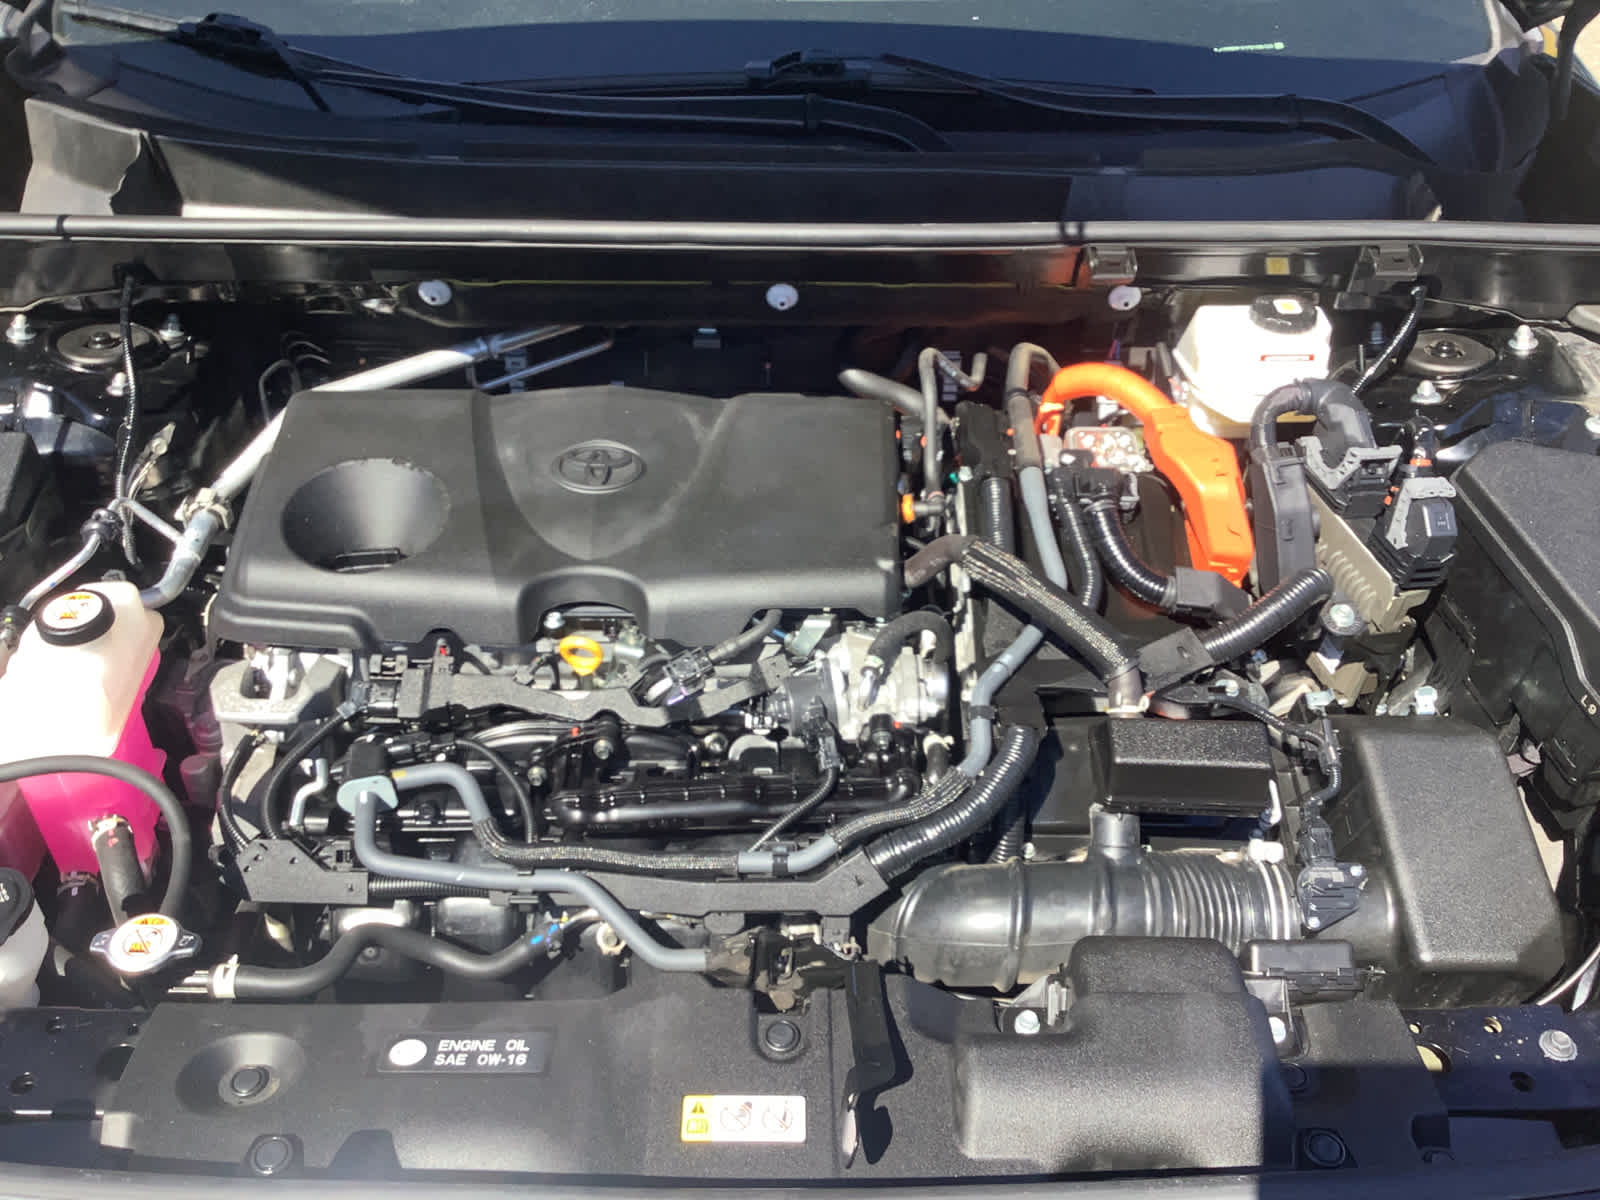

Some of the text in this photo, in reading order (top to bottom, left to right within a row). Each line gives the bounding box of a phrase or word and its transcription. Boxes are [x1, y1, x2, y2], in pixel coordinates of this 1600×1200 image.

[438, 1039, 530, 1052] ENGINE OIL
[434, 1053, 528, 1066] SAE 0W-16
